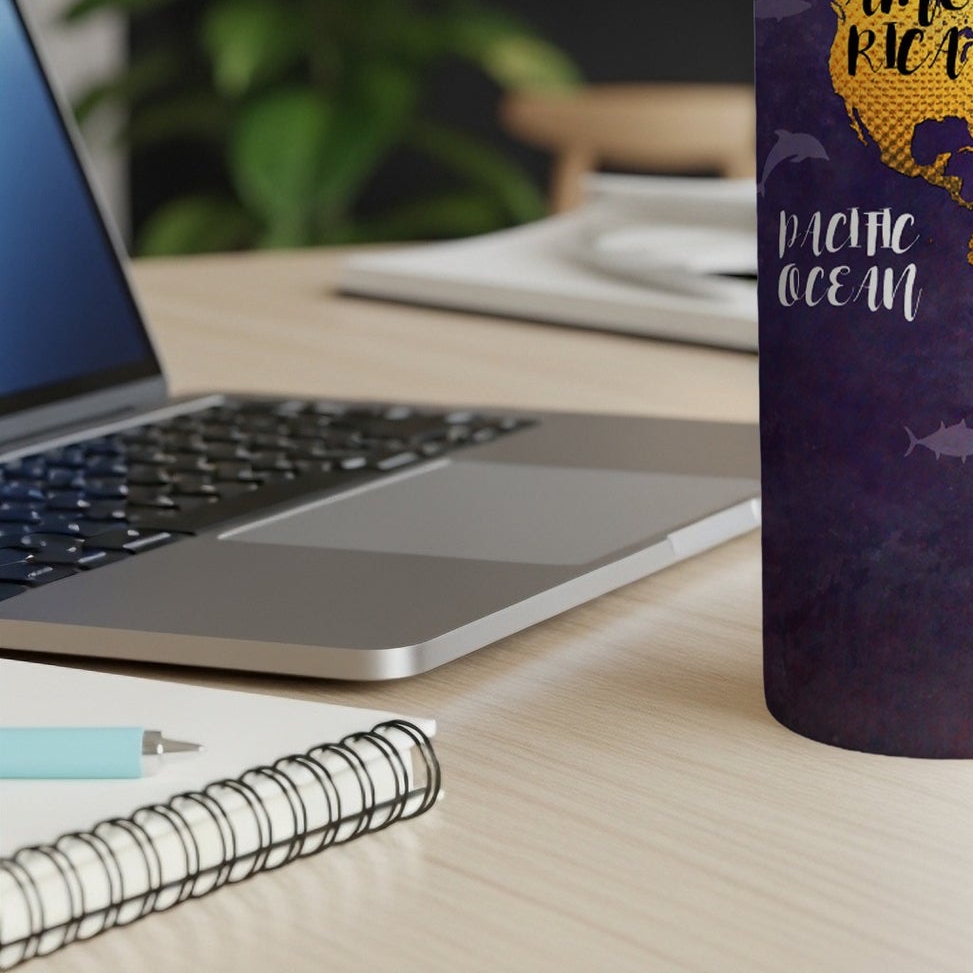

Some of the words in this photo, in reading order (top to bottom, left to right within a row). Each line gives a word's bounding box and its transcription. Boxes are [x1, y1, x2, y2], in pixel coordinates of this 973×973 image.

[847, 22, 973, 80] RICA
[778, 207, 920, 259] PACIFIC
[777, 262, 922, 322] OCEAN
